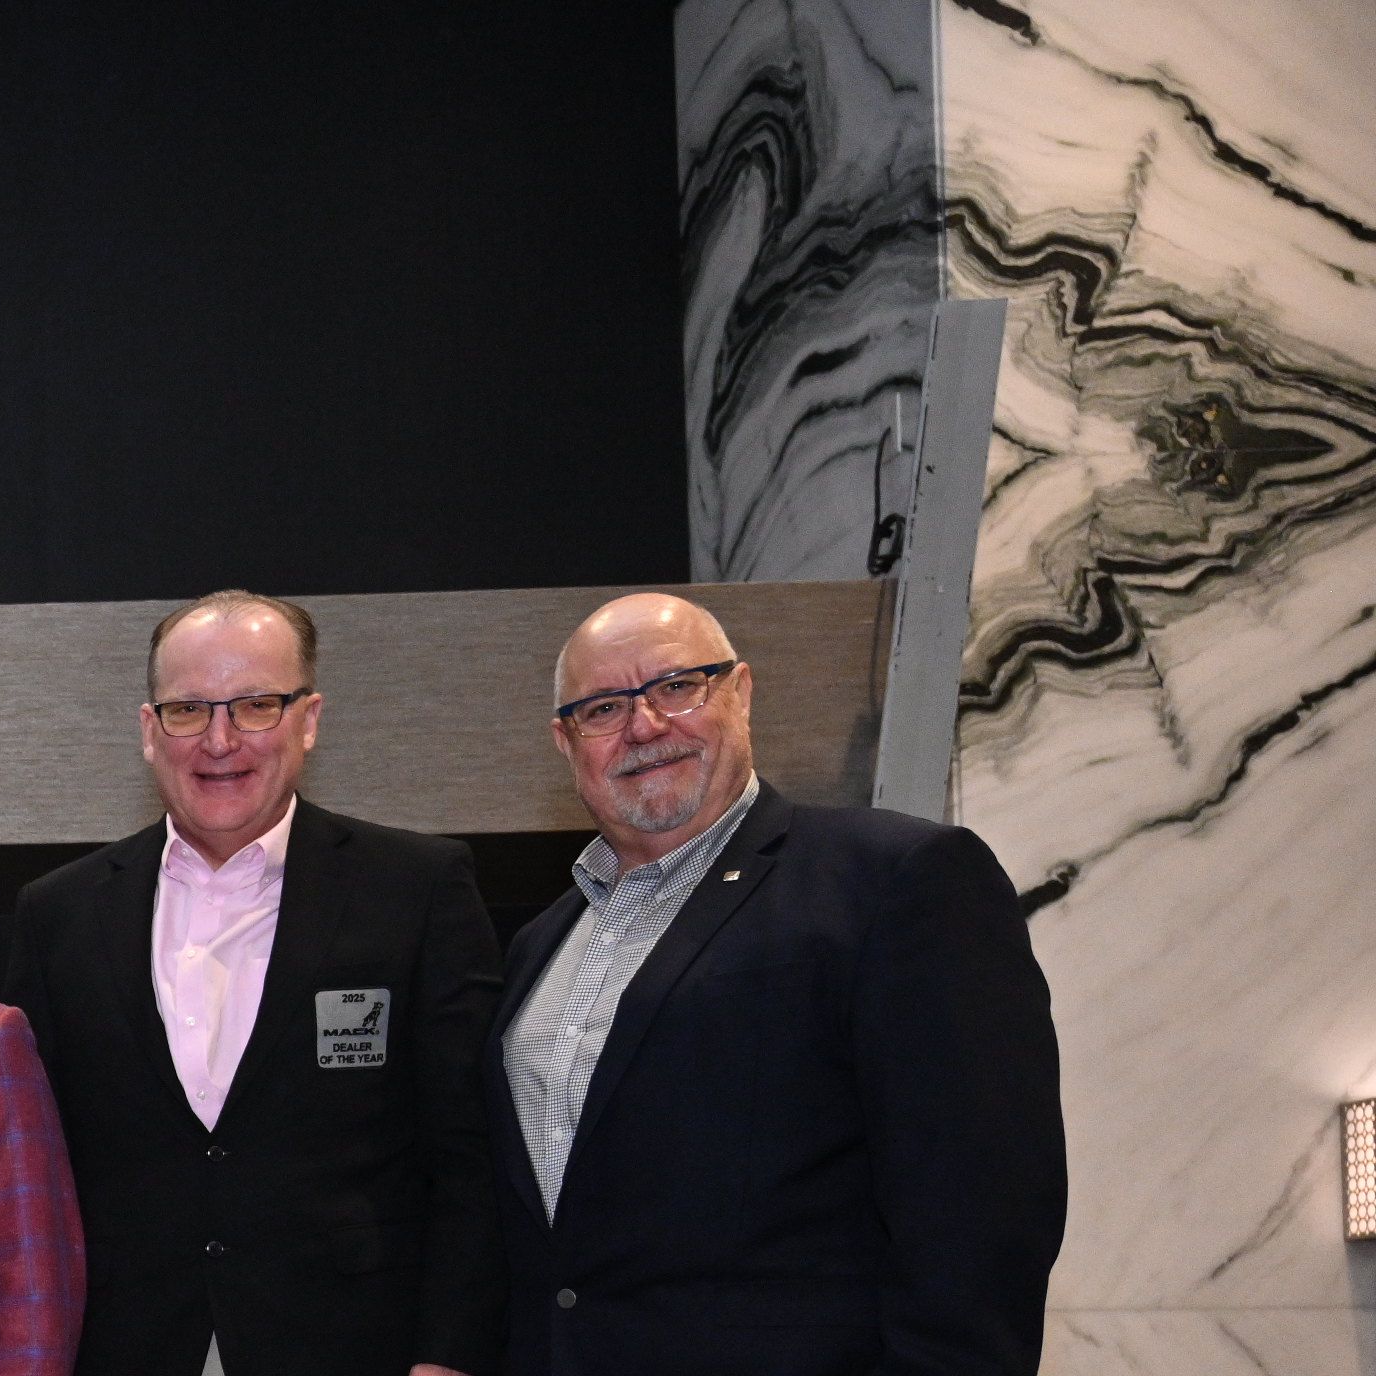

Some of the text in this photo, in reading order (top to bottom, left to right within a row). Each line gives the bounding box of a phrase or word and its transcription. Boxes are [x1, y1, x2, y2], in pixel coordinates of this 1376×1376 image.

[342, 993, 366, 1003] 2025
[323, 1028, 376, 1037] MACK
[333, 1042, 372, 1052] DEALER
[320, 1053, 384, 1065] OF THE YEAR
